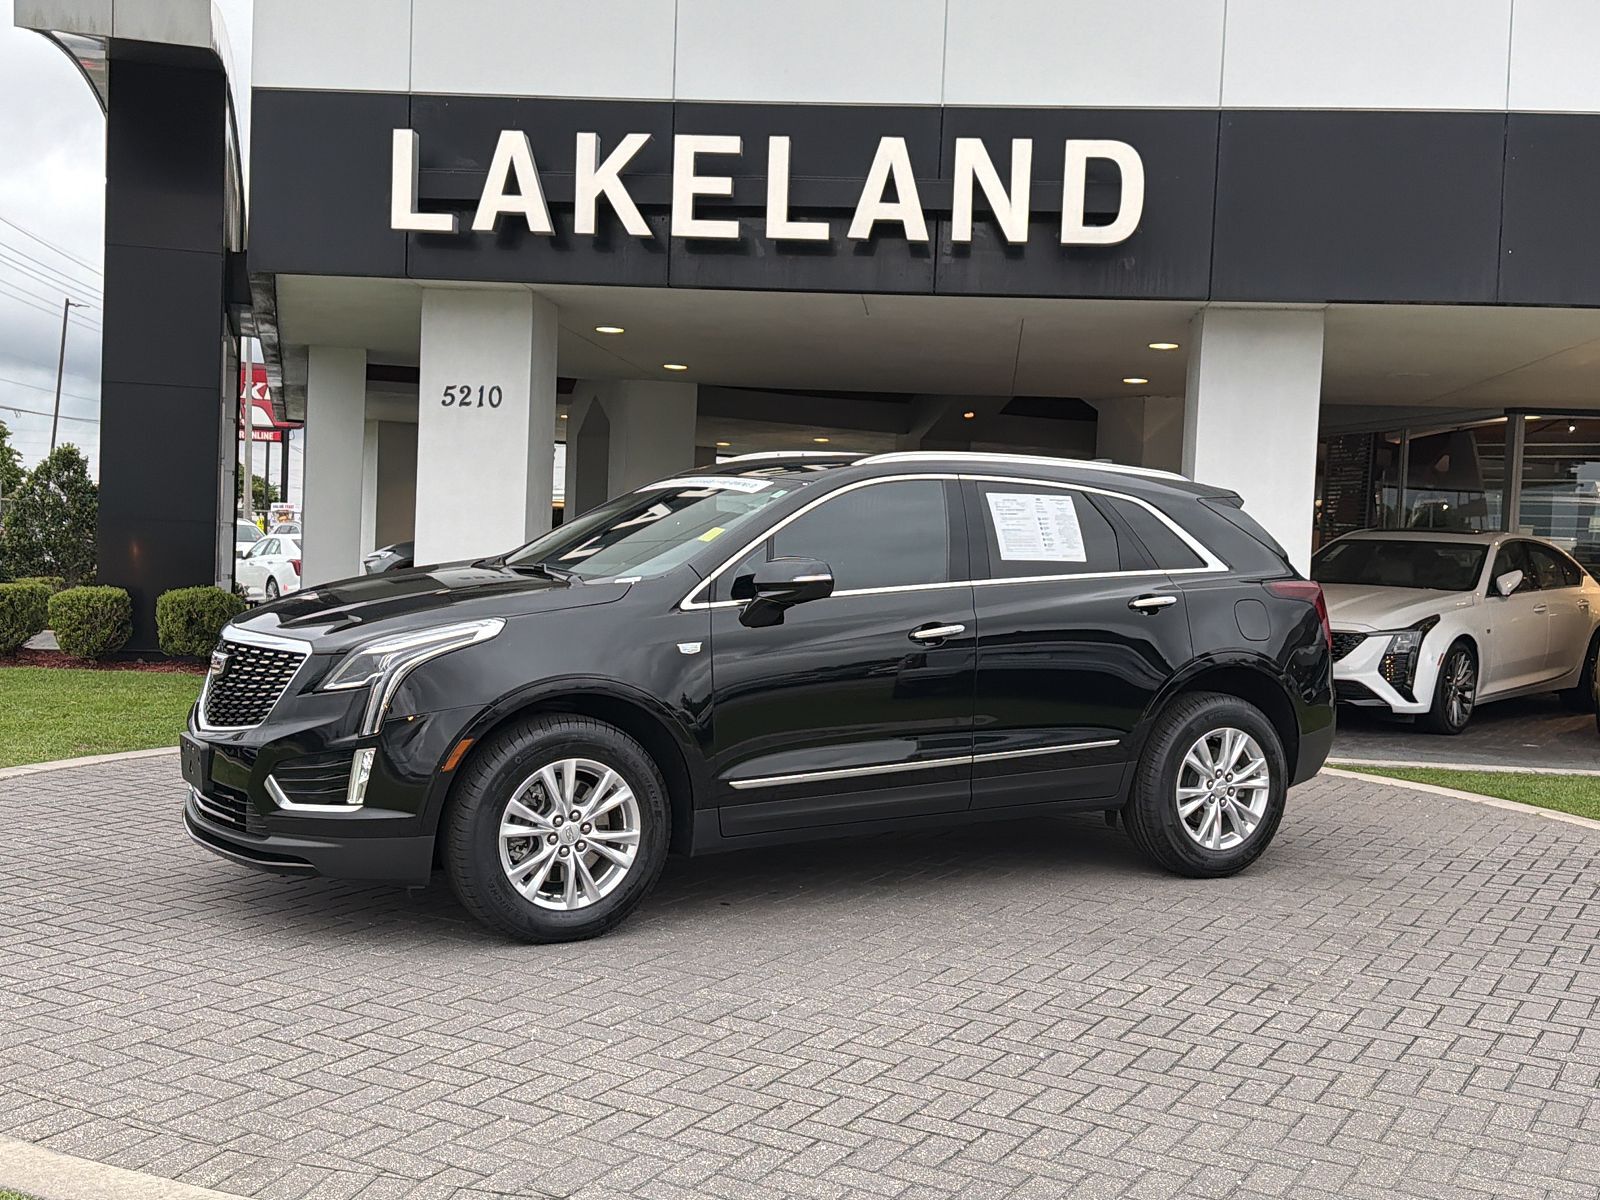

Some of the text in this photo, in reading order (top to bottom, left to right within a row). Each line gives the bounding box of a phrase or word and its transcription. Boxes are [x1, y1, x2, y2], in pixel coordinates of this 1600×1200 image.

[391, 128, 1145, 246] LAKELAND
[441, 385, 503, 408] 5210
[247, 431, 274, 440] NLINE
